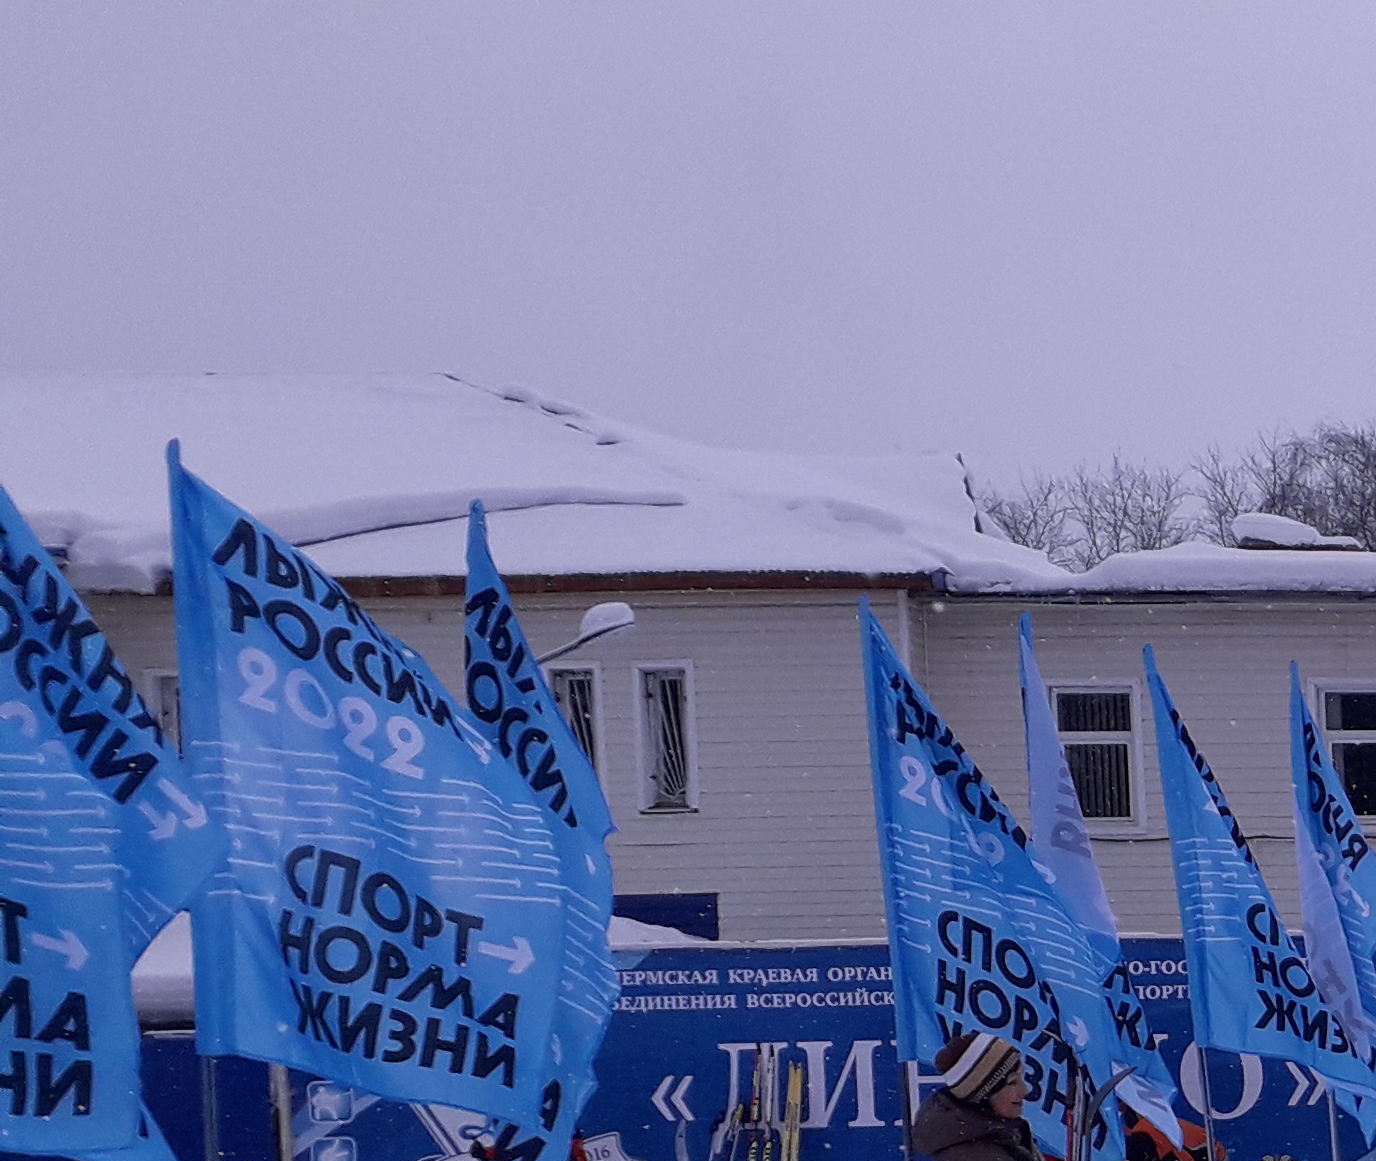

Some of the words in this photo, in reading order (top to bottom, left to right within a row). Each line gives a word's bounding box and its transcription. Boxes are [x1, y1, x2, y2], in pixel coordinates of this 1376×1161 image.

[236, 646, 426, 780] 2022
[284, 845, 485, 967] СПОРТ
[279, 908, 521, 1040] НОРМА
[290, 978, 516, 1088] ЖИЗНИ
[727, 967, 818, 987] КРАЕВАЯ
